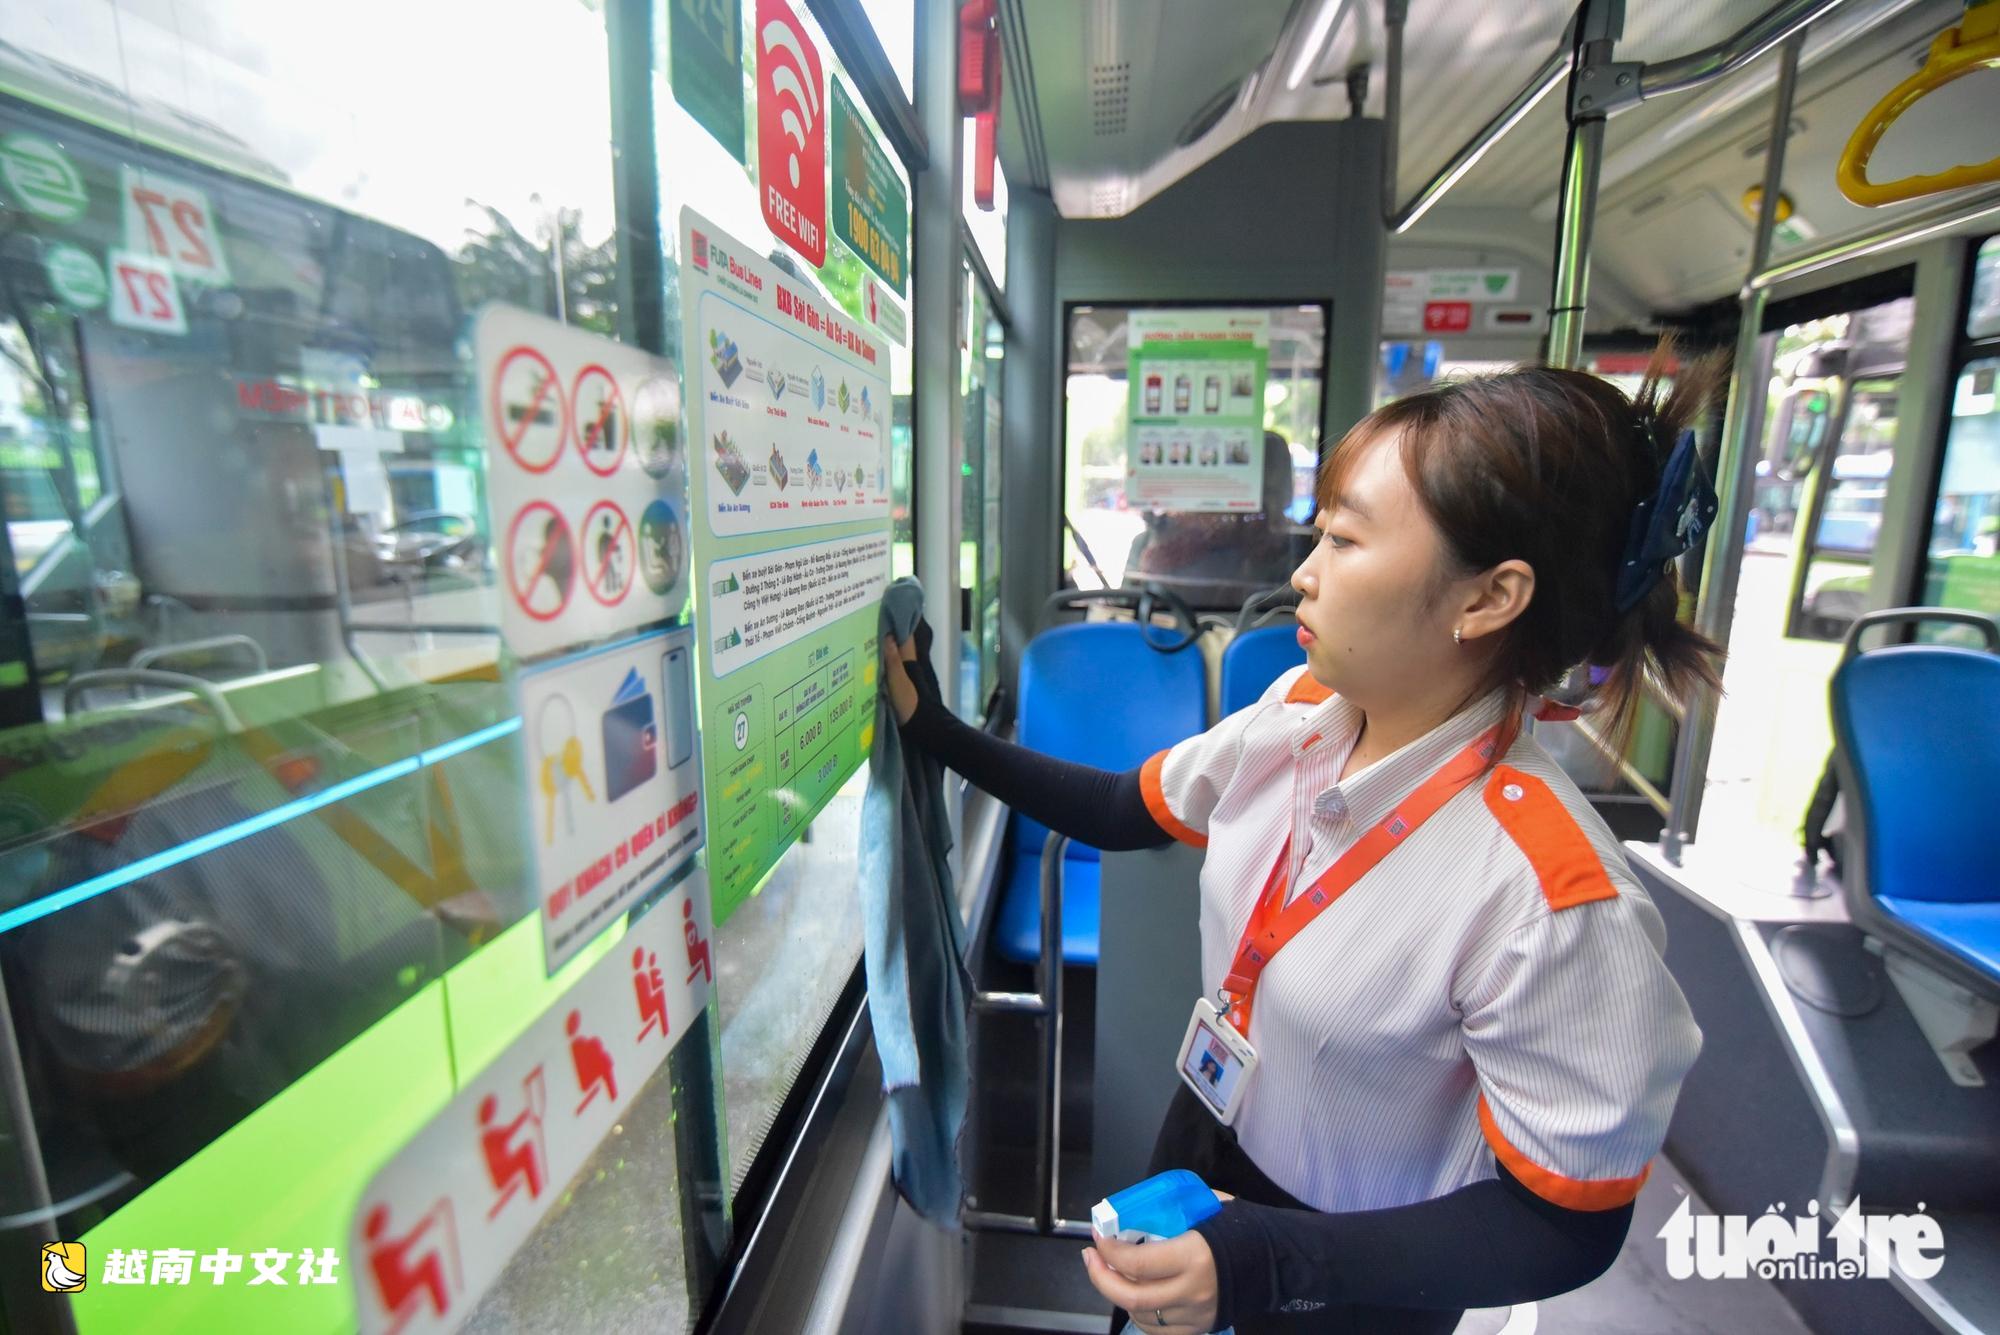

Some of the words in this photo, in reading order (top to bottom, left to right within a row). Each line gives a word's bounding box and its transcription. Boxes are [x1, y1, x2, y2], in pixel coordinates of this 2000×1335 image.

[768, 184, 797, 235] FREE
[798, 212, 819, 253] WIFI
[710, 244, 729, 272] FUTA
[730, 256, 743, 280] Bus
[745, 264, 762, 291] Lines
[737, 721, 745, 742] 27
[800, 725, 816, 750] 6.000
